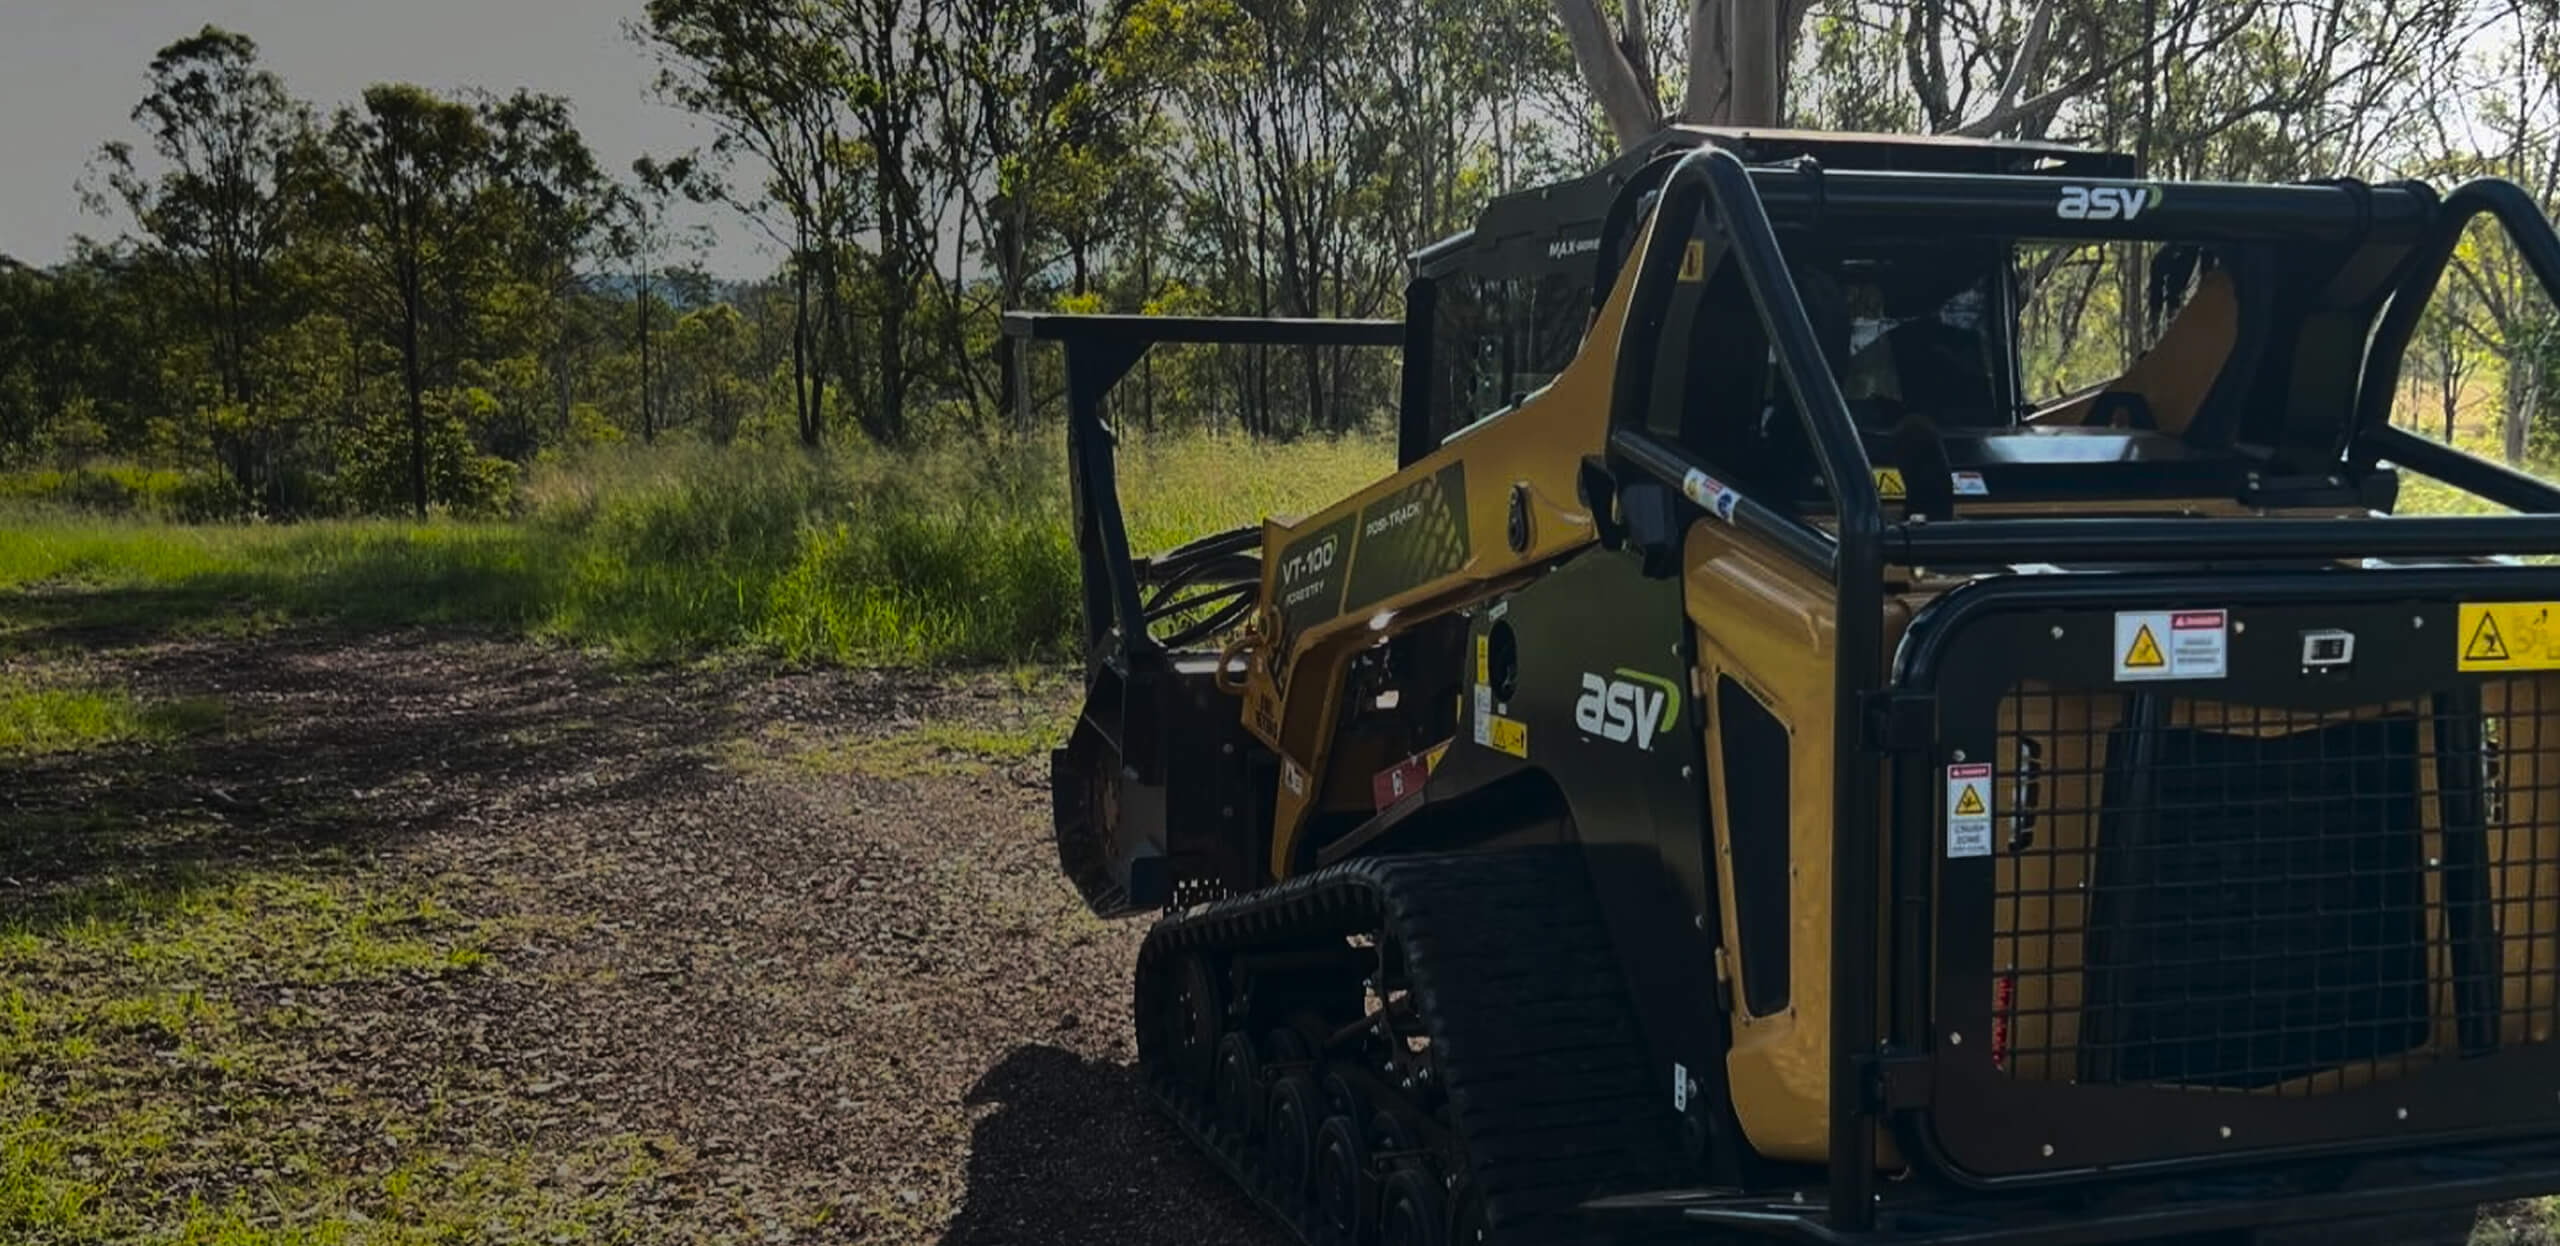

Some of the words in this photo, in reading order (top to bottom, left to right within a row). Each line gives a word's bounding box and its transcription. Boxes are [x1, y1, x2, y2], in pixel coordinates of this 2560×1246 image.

[2057, 186, 2147, 220] asv
[1366, 500, 1422, 537] POSI-TRACK
[1282, 541, 1333, 585] VT-100
[1576, 672, 1664, 750] asv
